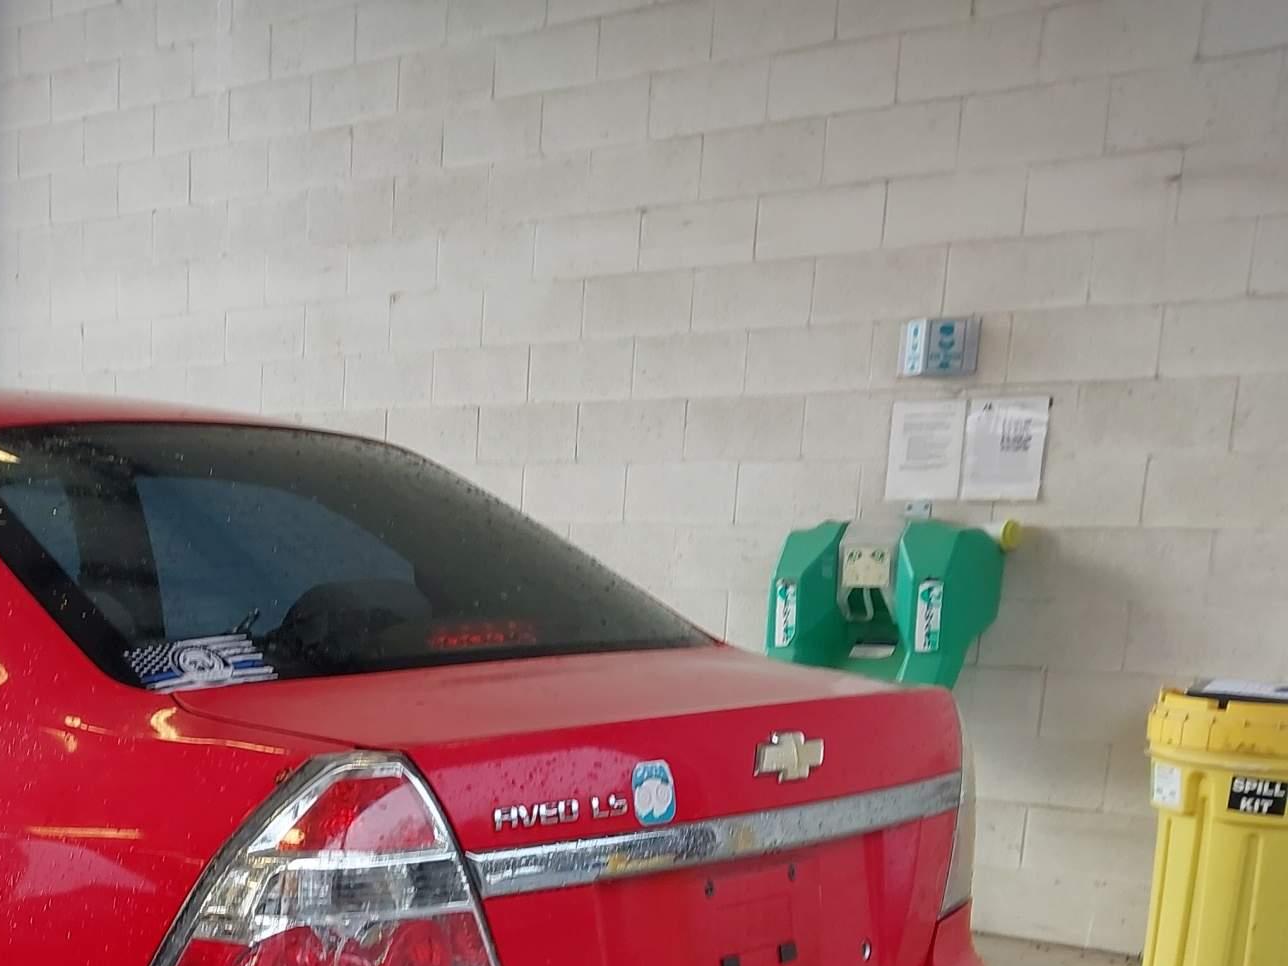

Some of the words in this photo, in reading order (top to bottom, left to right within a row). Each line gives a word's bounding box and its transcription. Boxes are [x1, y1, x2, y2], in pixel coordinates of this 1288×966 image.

[1232, 778, 1286, 798] SPILL
[494, 798, 579, 831] AVEO
[592, 793, 628, 819] LS
[1239, 796, 1274, 815] KIT
